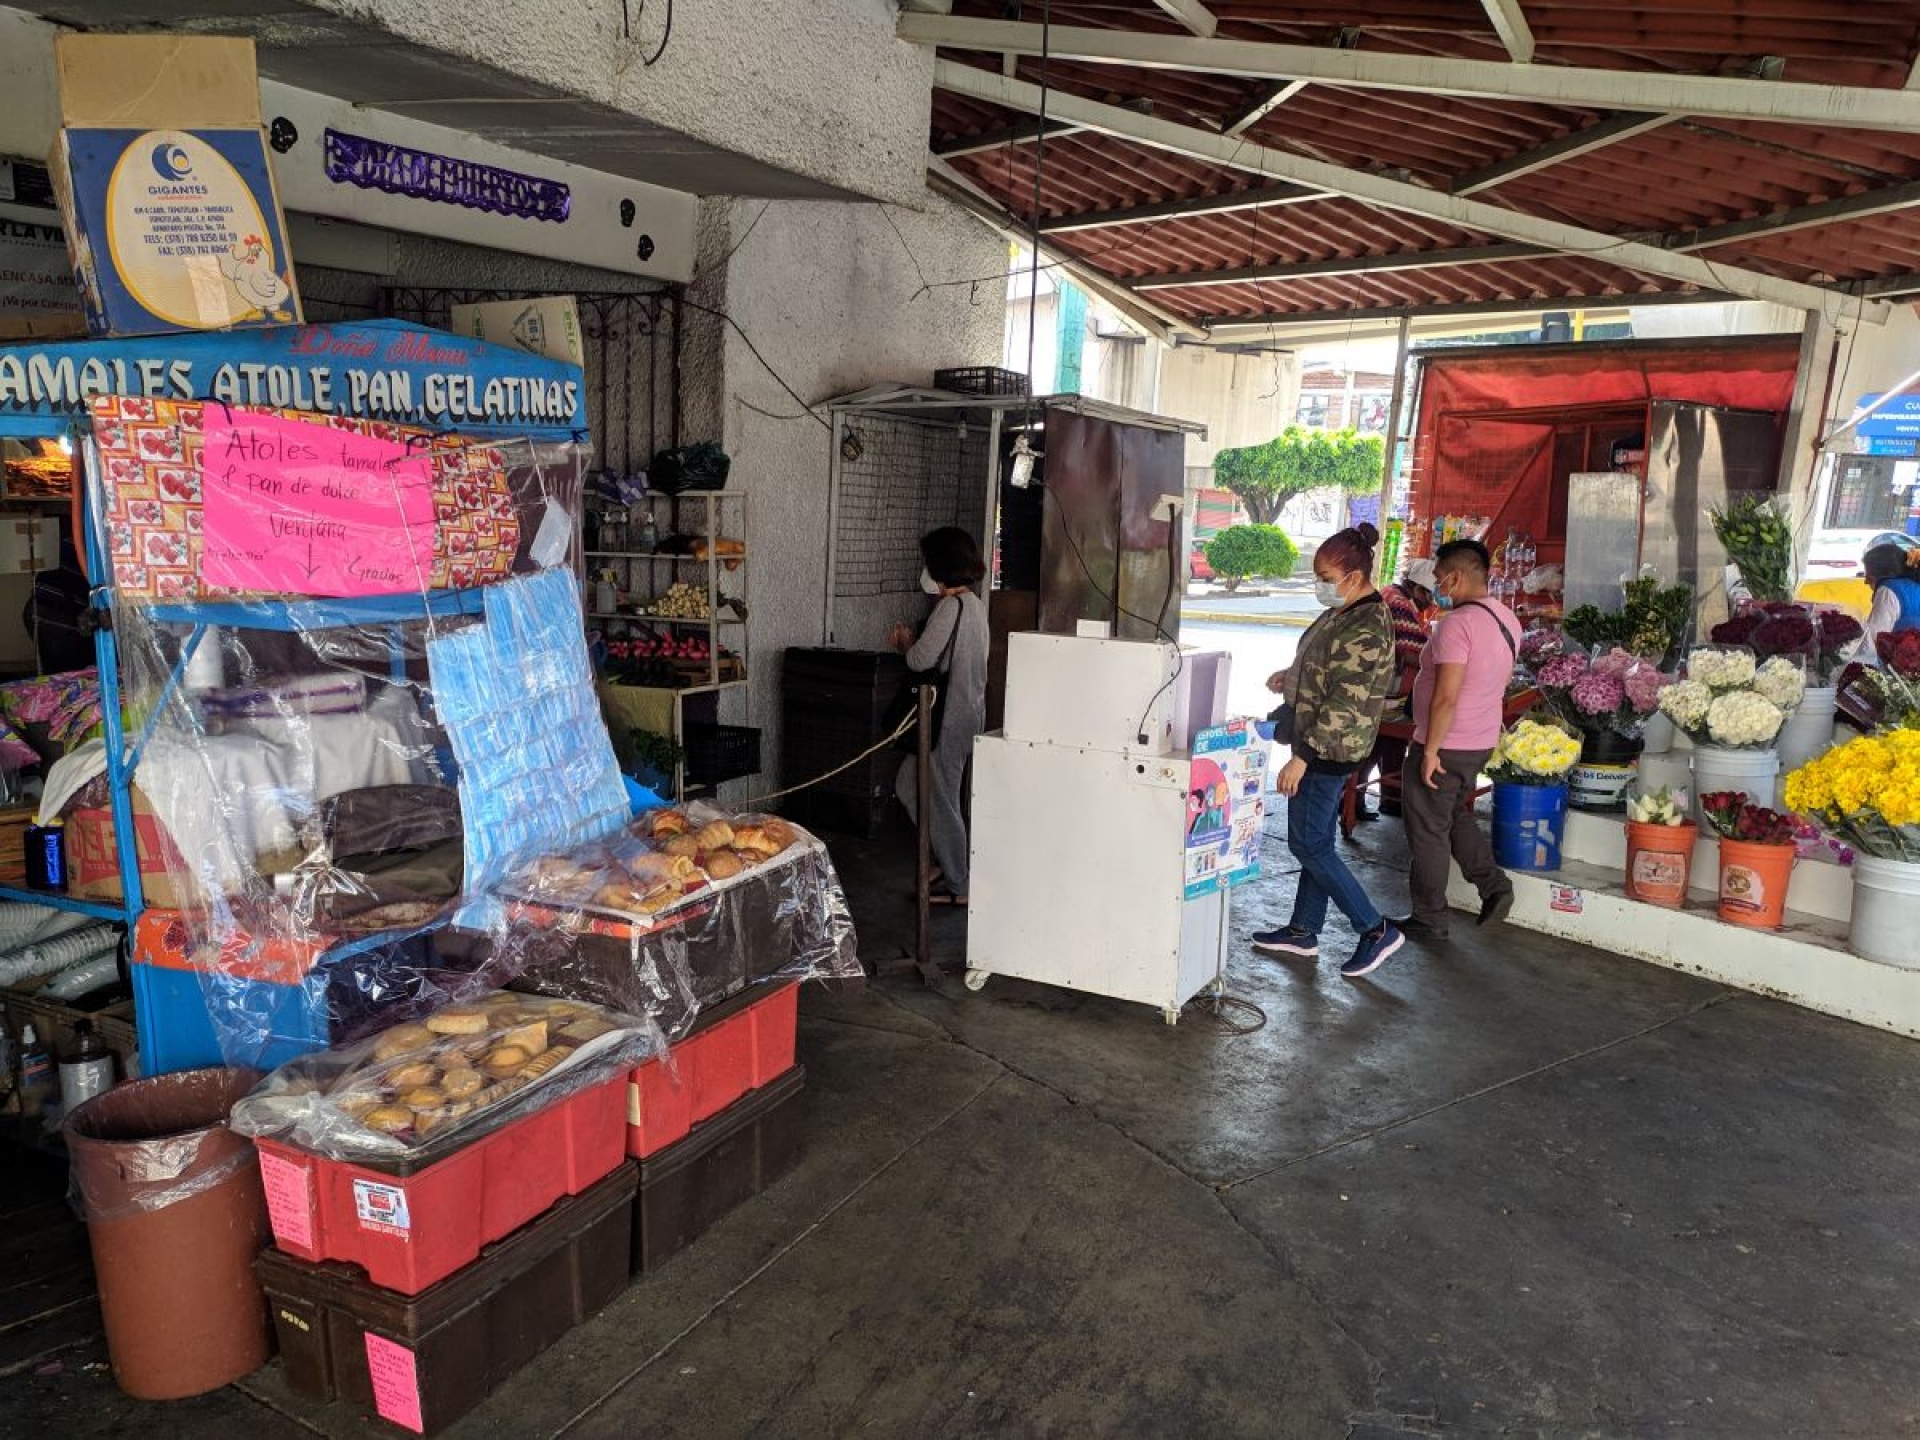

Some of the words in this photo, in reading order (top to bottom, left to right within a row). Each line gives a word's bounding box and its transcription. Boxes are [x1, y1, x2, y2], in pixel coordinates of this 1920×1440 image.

[148, 186, 208, 195] GIGANTES
[424, 373, 578, 422] GELATINAS
[291, 476, 309, 495] de
[321, 480, 360, 501] dulce
